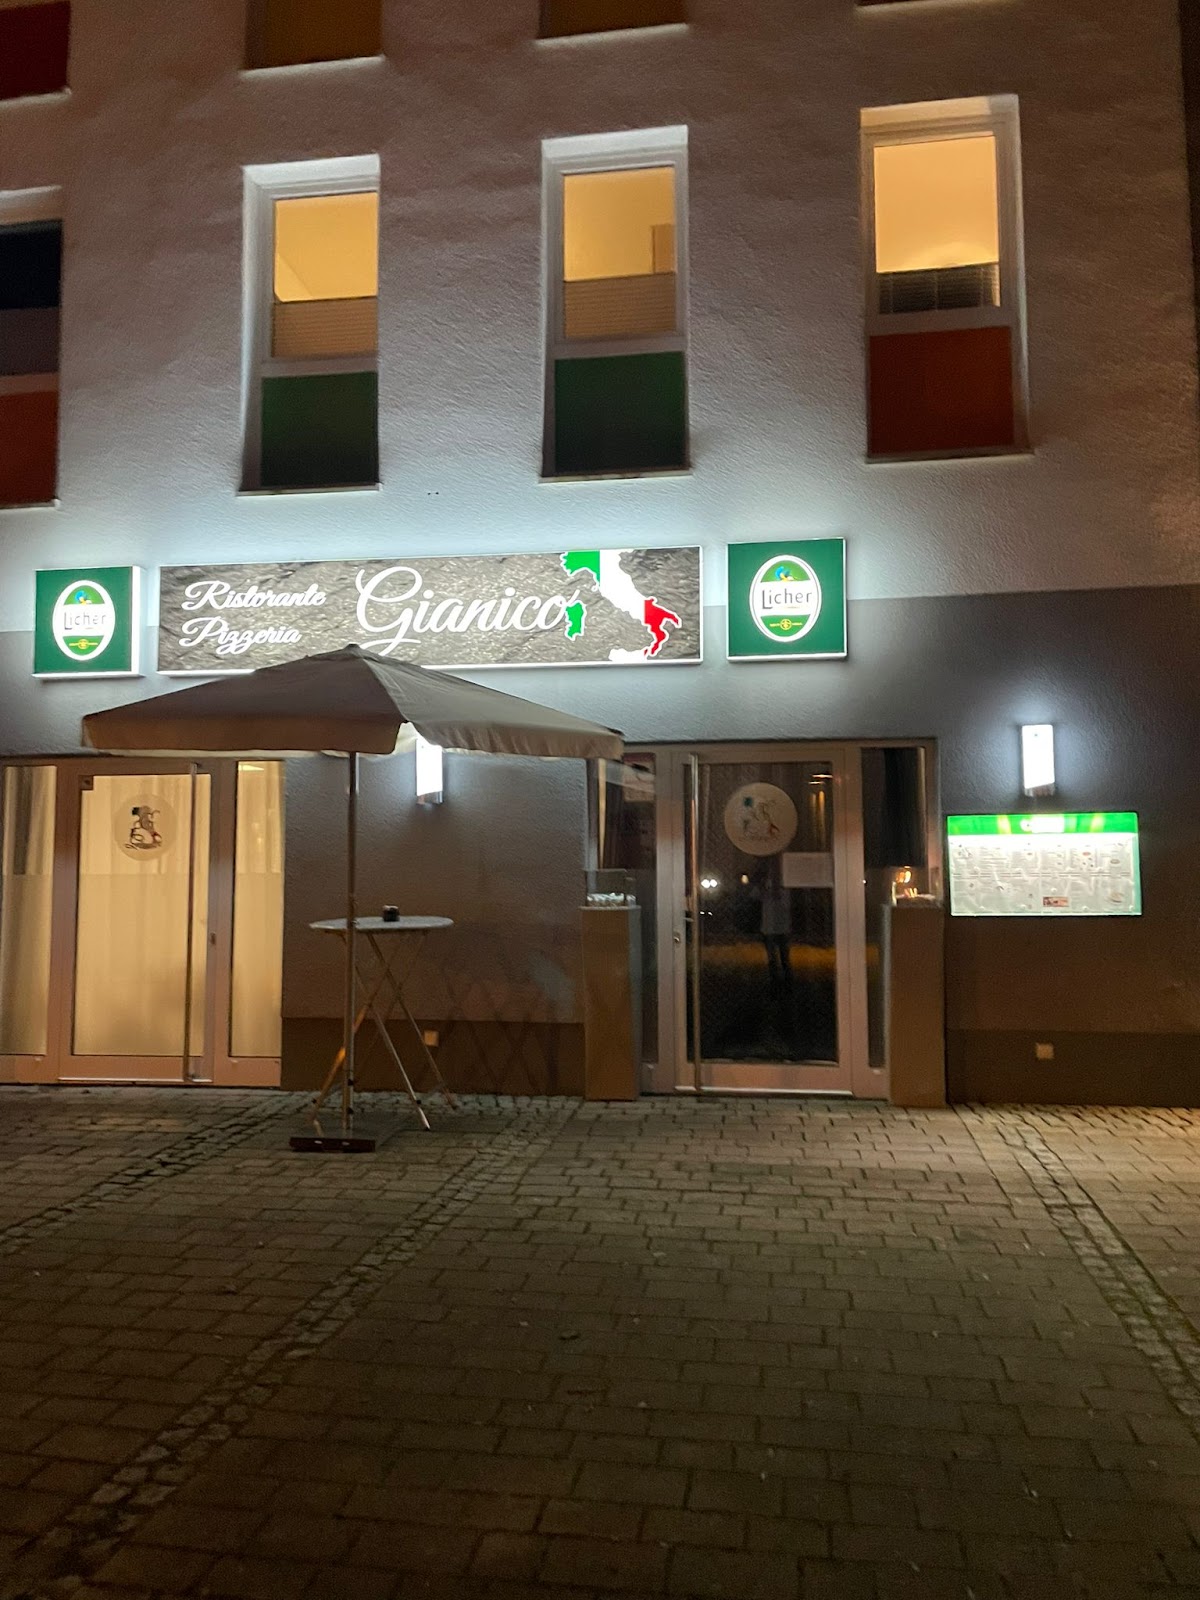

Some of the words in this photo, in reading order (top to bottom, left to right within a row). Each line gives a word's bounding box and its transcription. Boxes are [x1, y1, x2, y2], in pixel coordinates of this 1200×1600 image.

[180, 580, 328, 611] Ristorante
[761, 588, 813, 610] Licher
[63, 611, 107, 631] Licher
[355, 566, 579, 657] Gianico
[177, 616, 303, 656] Pizzeria
